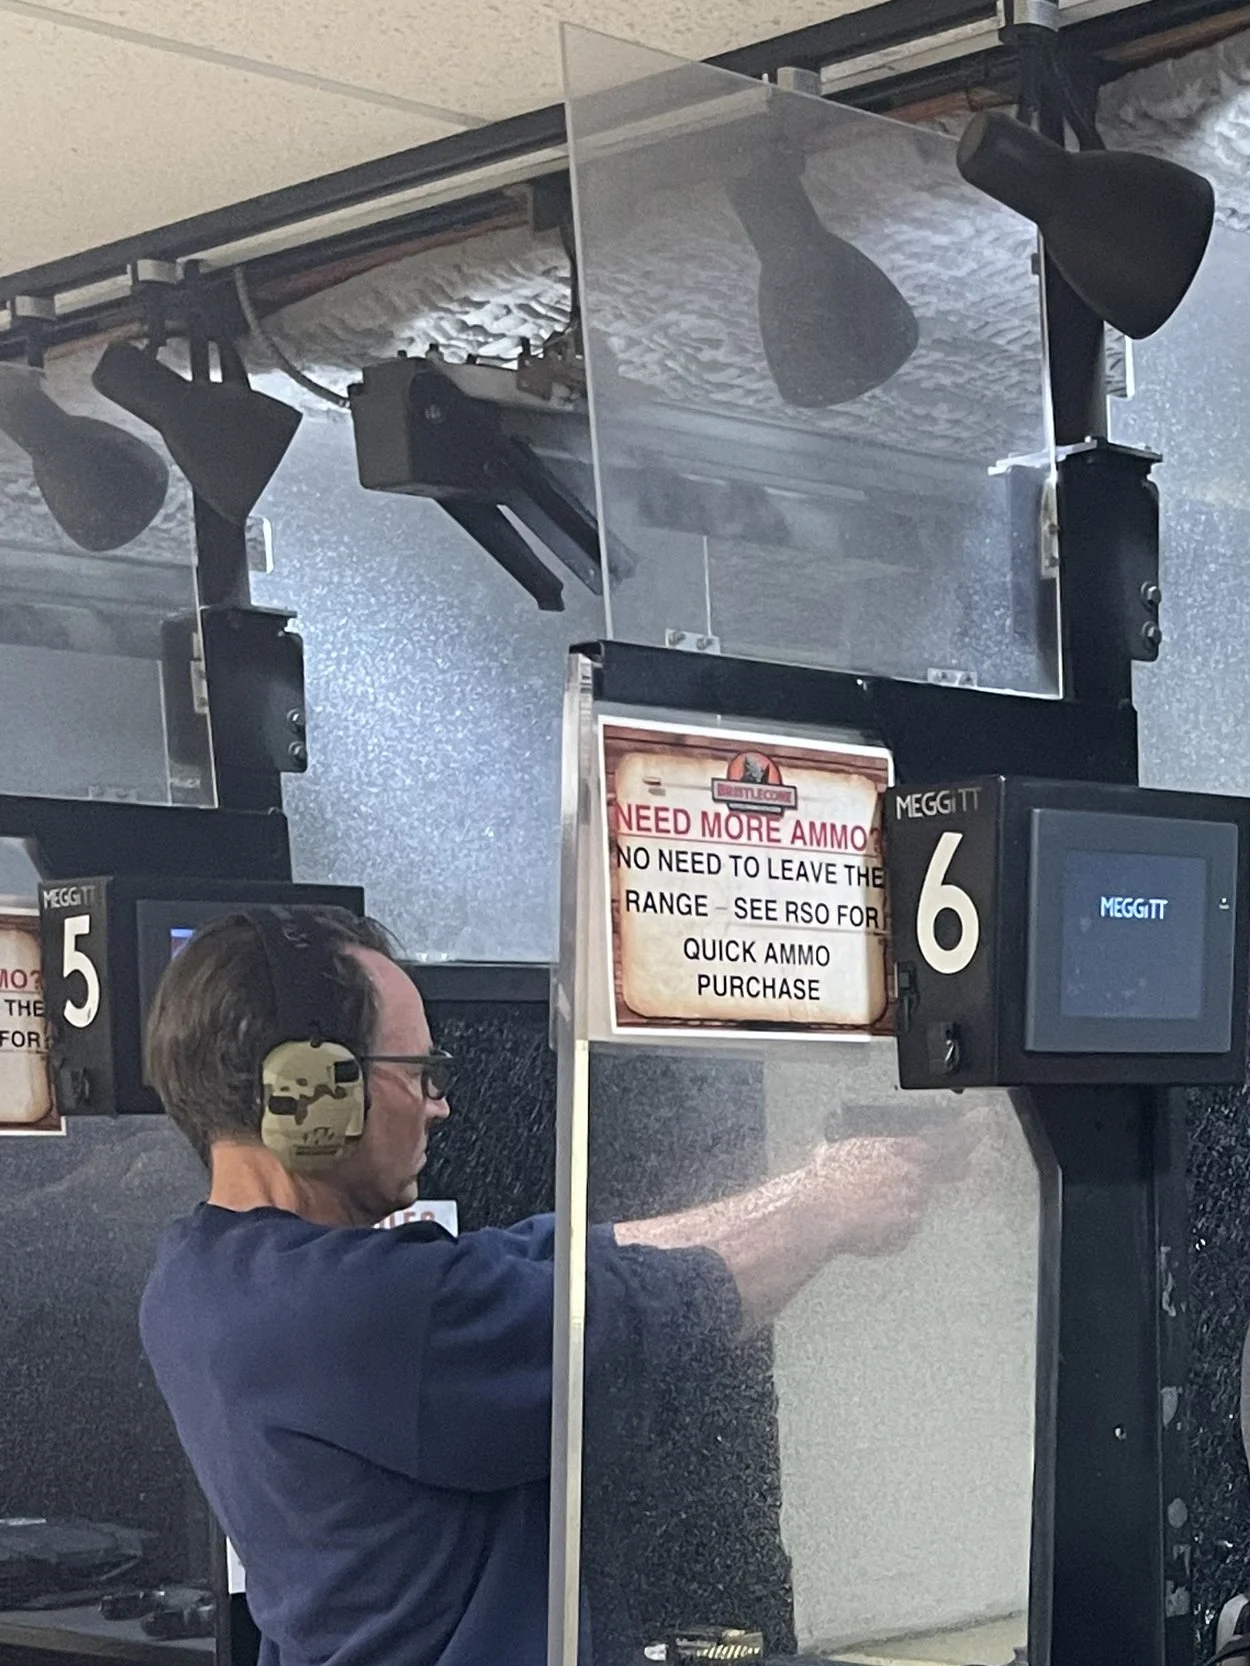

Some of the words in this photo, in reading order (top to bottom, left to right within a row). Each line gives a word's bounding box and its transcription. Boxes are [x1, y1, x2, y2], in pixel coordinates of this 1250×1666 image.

[614, 803, 692, 836] NEED
[701, 810, 782, 844] MORE
[617, 846, 651, 870] NO
[658, 848, 722, 876] NEED
[728, 854, 760, 878] TO
[767, 857, 838, 884] LEAVE
[844, 863, 885, 888] THE
[625, 889, 709, 917] RANGE
[734, 896, 778, 921] SEE
[785, 900, 830, 925] RSO
[837, 904, 879, 929] FOR
[916, 831, 980, 975] 6
[63, 915, 100, 1028] 5
[683, 937, 757, 964] QUICK
[764, 941, 831, 968] AMMO
[697, 973, 821, 1000] PURCHASE
[4, 999, 45, 1018] THE
[0, 1029, 41, 1049] FOR
